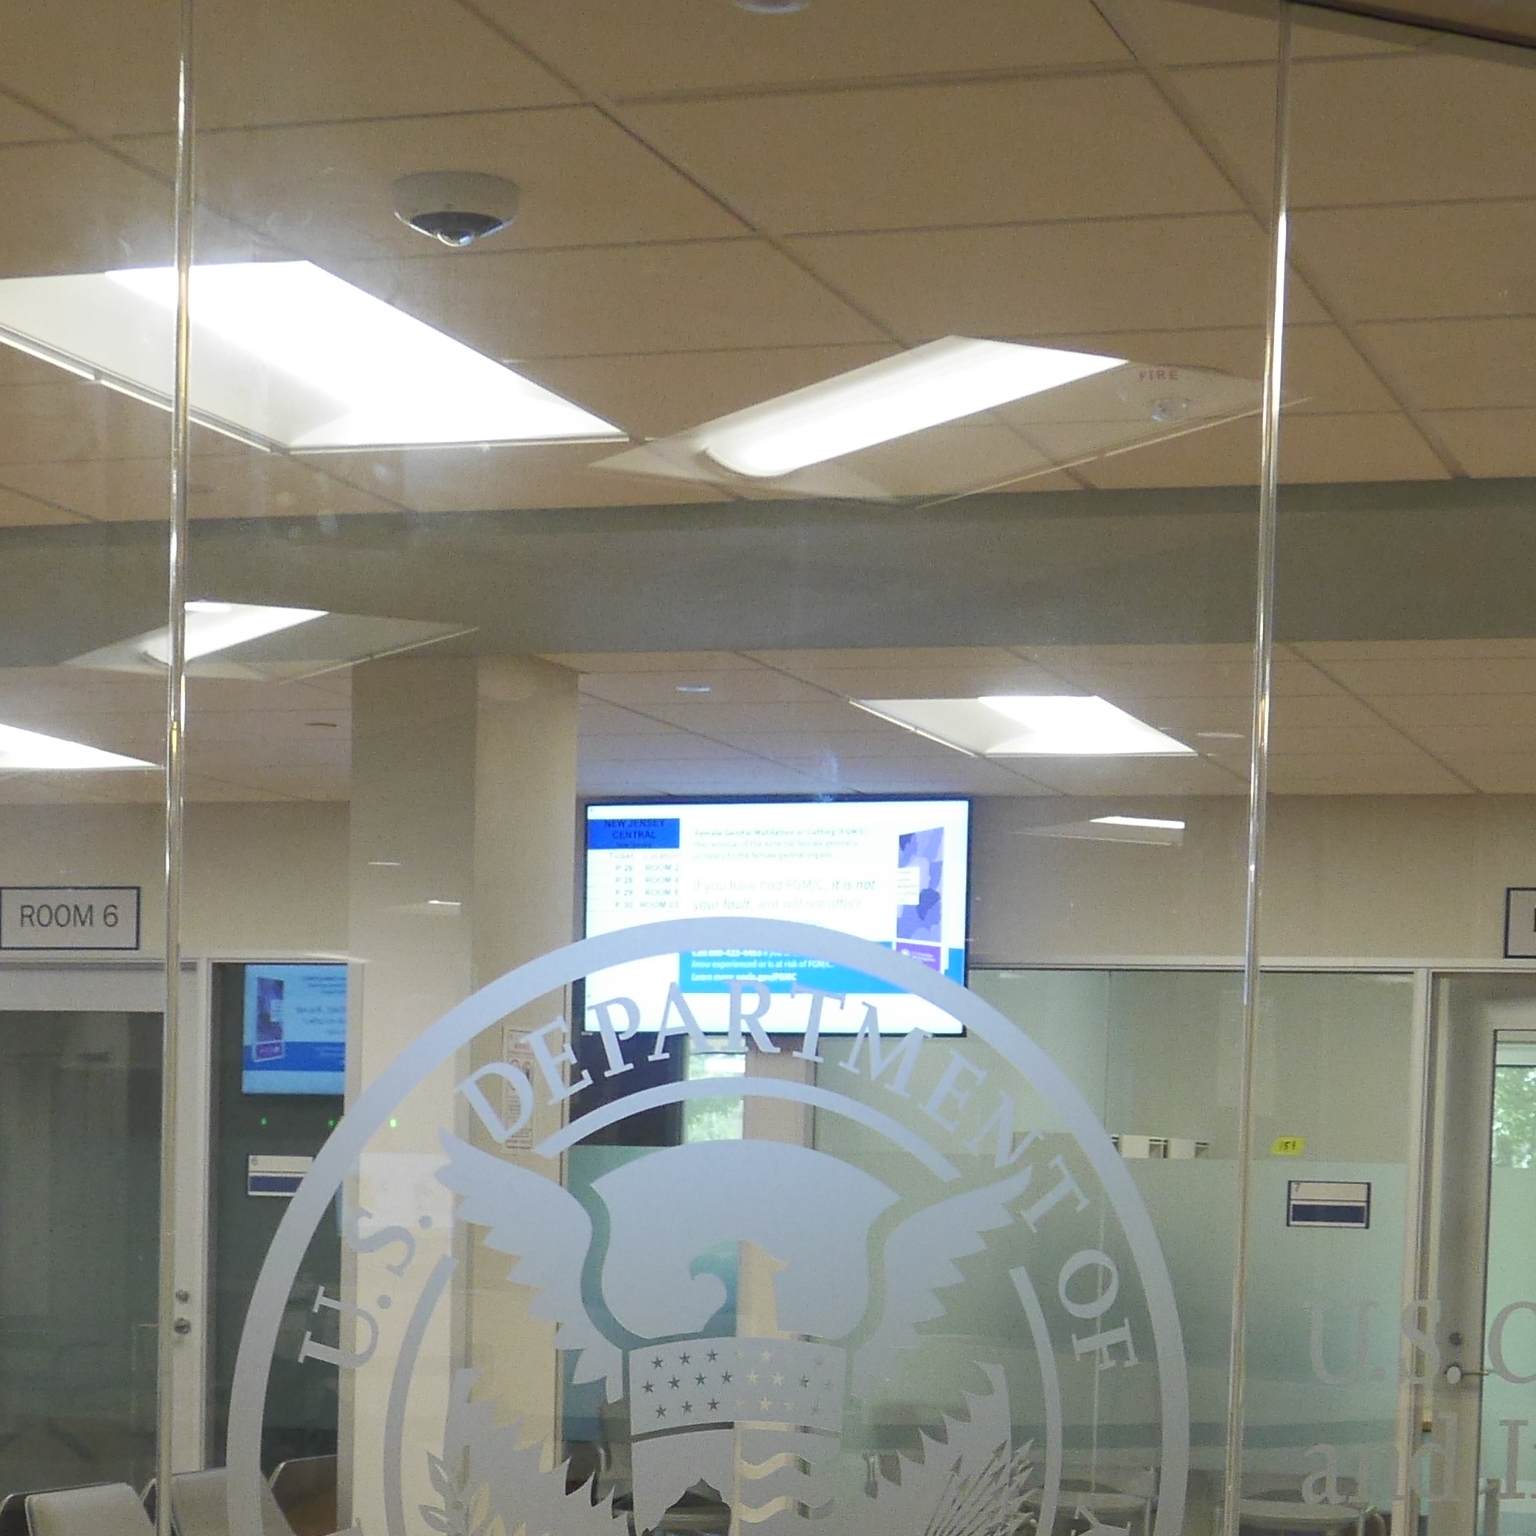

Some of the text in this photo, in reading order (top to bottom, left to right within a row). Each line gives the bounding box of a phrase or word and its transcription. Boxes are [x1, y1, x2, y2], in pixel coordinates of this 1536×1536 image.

[1139, 366, 1178, 382] FIRE
[611, 830, 657, 840] CENTRAL
[645, 864, 672, 873] ROOM
[645, 876, 672, 885] ROOM
[831, 879, 841, 891] it
[843, 879, 852, 891] is
[855, 878, 877, 891] not
[645, 888, 672, 897] ROOM
[639, 901, 667, 910] ROOM
[693, 900, 720, 912] your
[20, 904, 119, 928] ROOM 6
[298, 1206, 433, 1368] U.S.
[455, 978, 1090, 1233] DEPARTMENT
[1056, 1248, 1141, 1372] OF
[1309, 1300, 1462, 1386] U.S.
[1302, 1410, 1464, 1505] and
